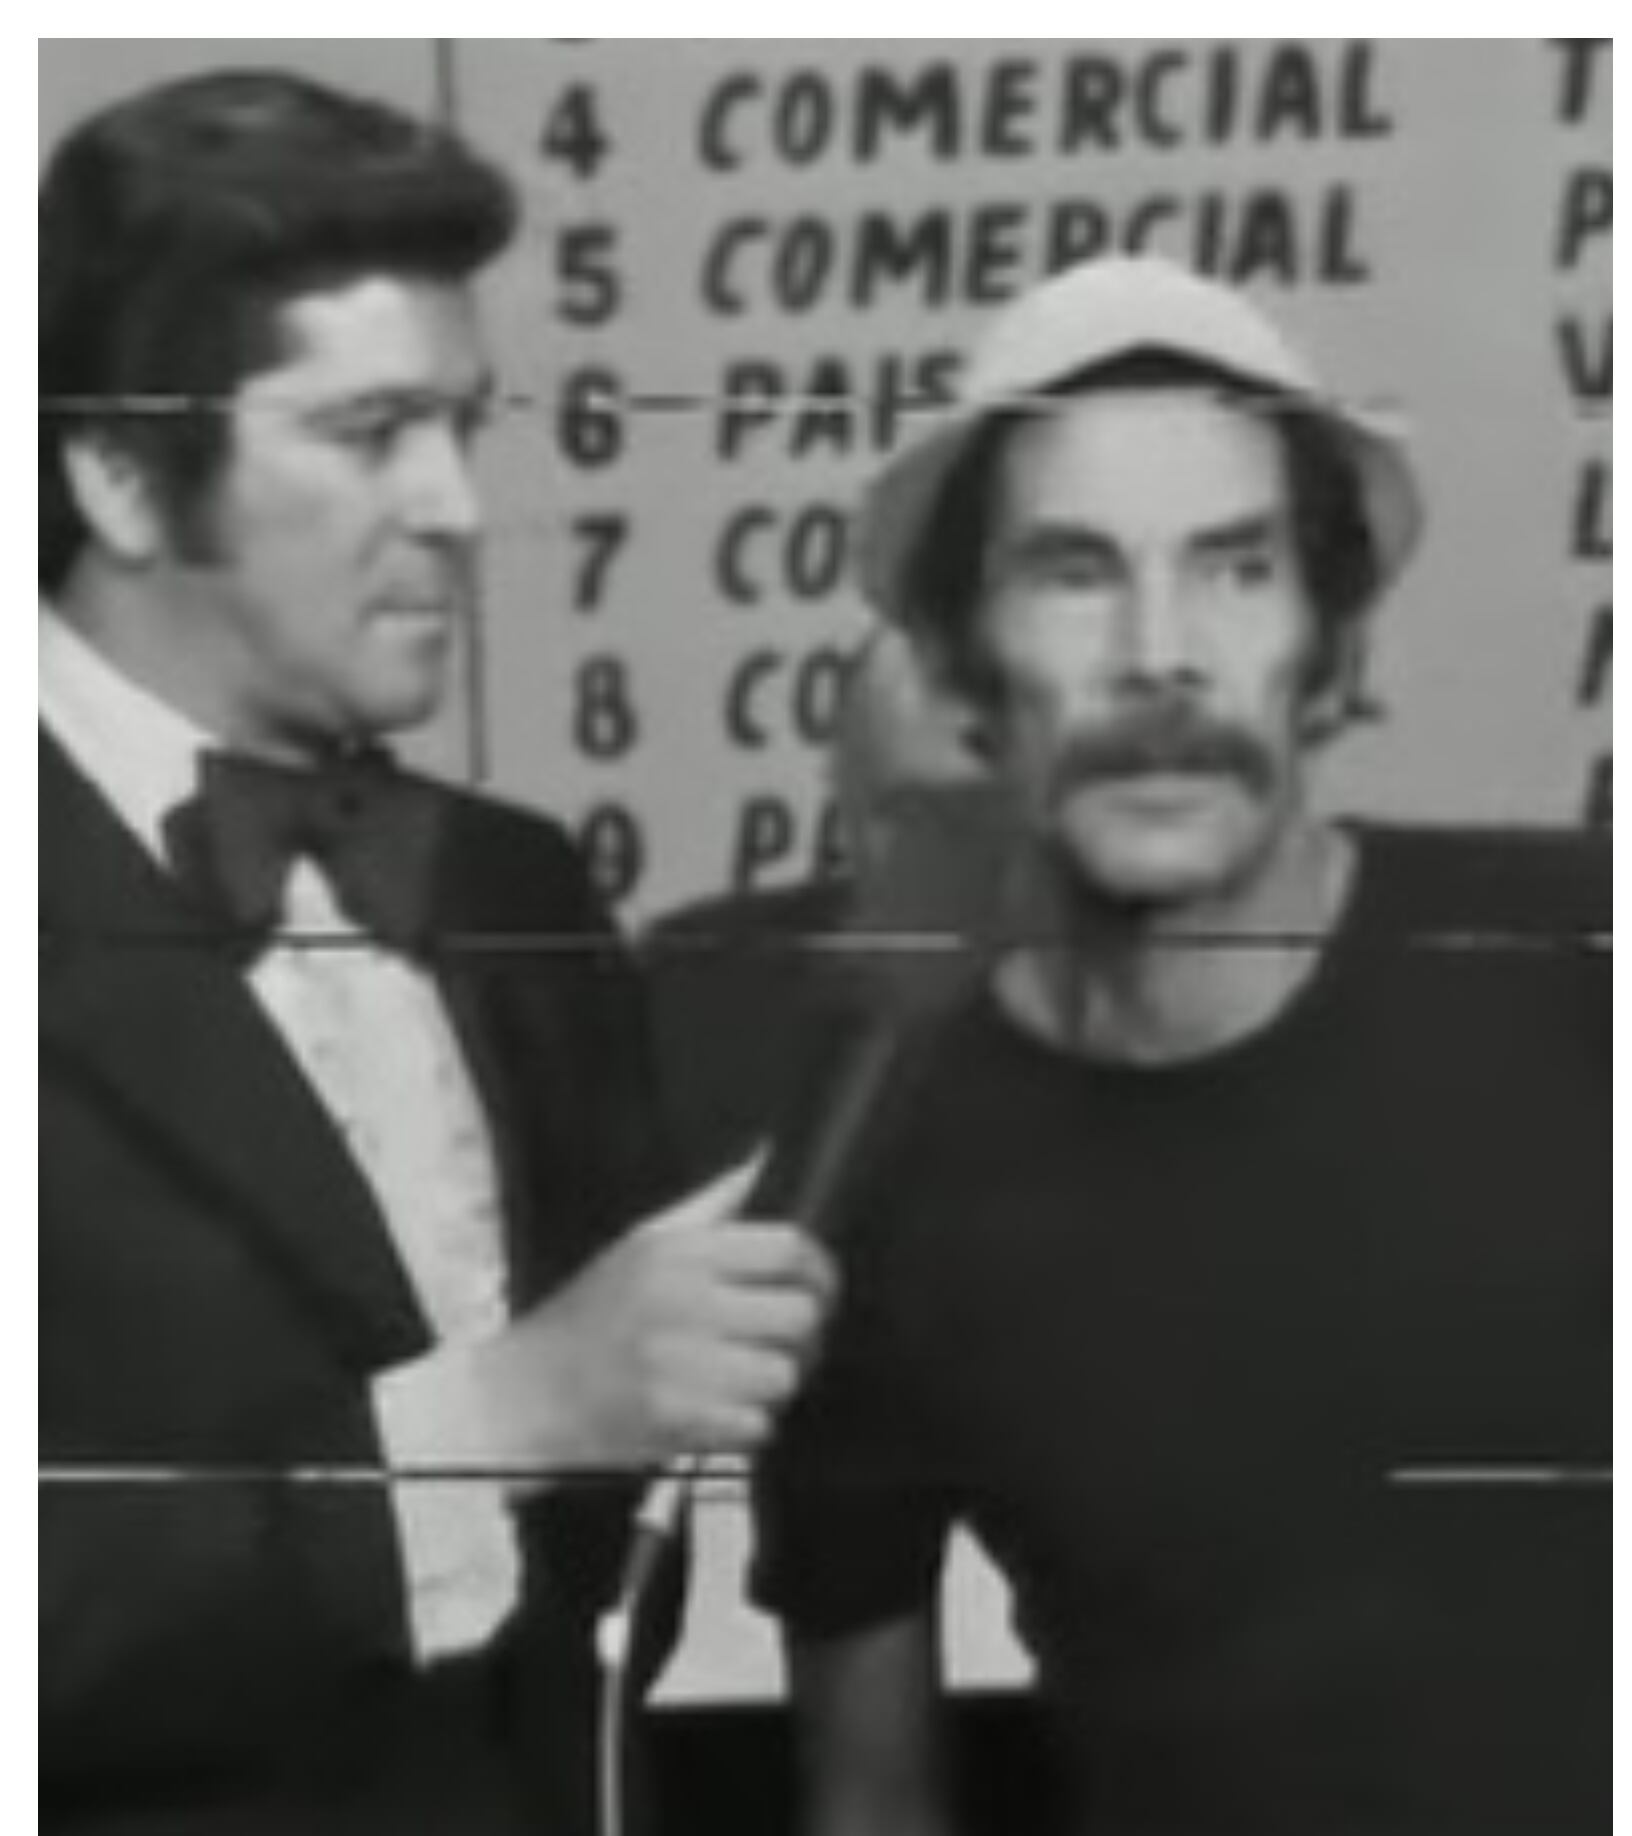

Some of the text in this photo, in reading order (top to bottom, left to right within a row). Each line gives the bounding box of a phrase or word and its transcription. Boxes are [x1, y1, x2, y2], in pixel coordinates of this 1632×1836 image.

[541, 80, 611, 180] 4
[702, 38, 1396, 172] COMERCIAL
[555, 223, 620, 330] 5
[703, 187, 1369, 315] COMERCIAL
[557, 361, 623, 468] 6
[571, 514, 628, 612] 7
[573, 652, 637, 764] 8
